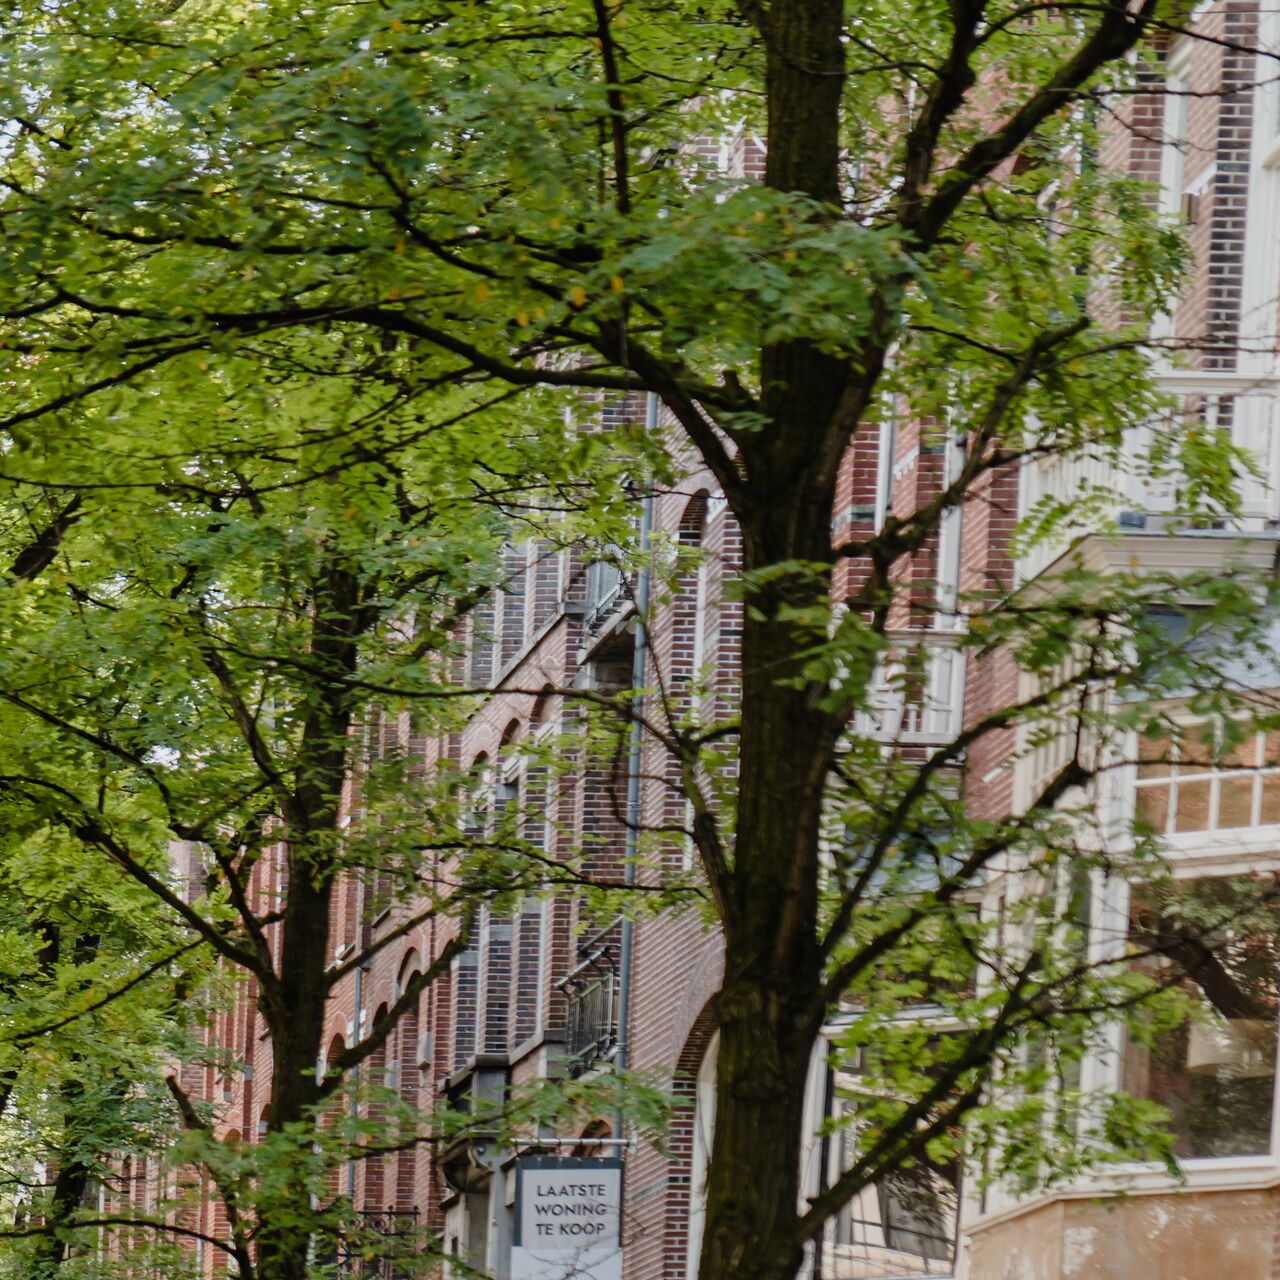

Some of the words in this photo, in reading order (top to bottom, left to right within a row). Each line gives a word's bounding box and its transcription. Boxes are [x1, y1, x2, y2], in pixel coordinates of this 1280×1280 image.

[537, 1184, 606, 1197] LAATSTE
[534, 1203, 608, 1216] WONING
[536, 1223, 554, 1236] TE
[560, 1222, 606, 1236] KOOP
